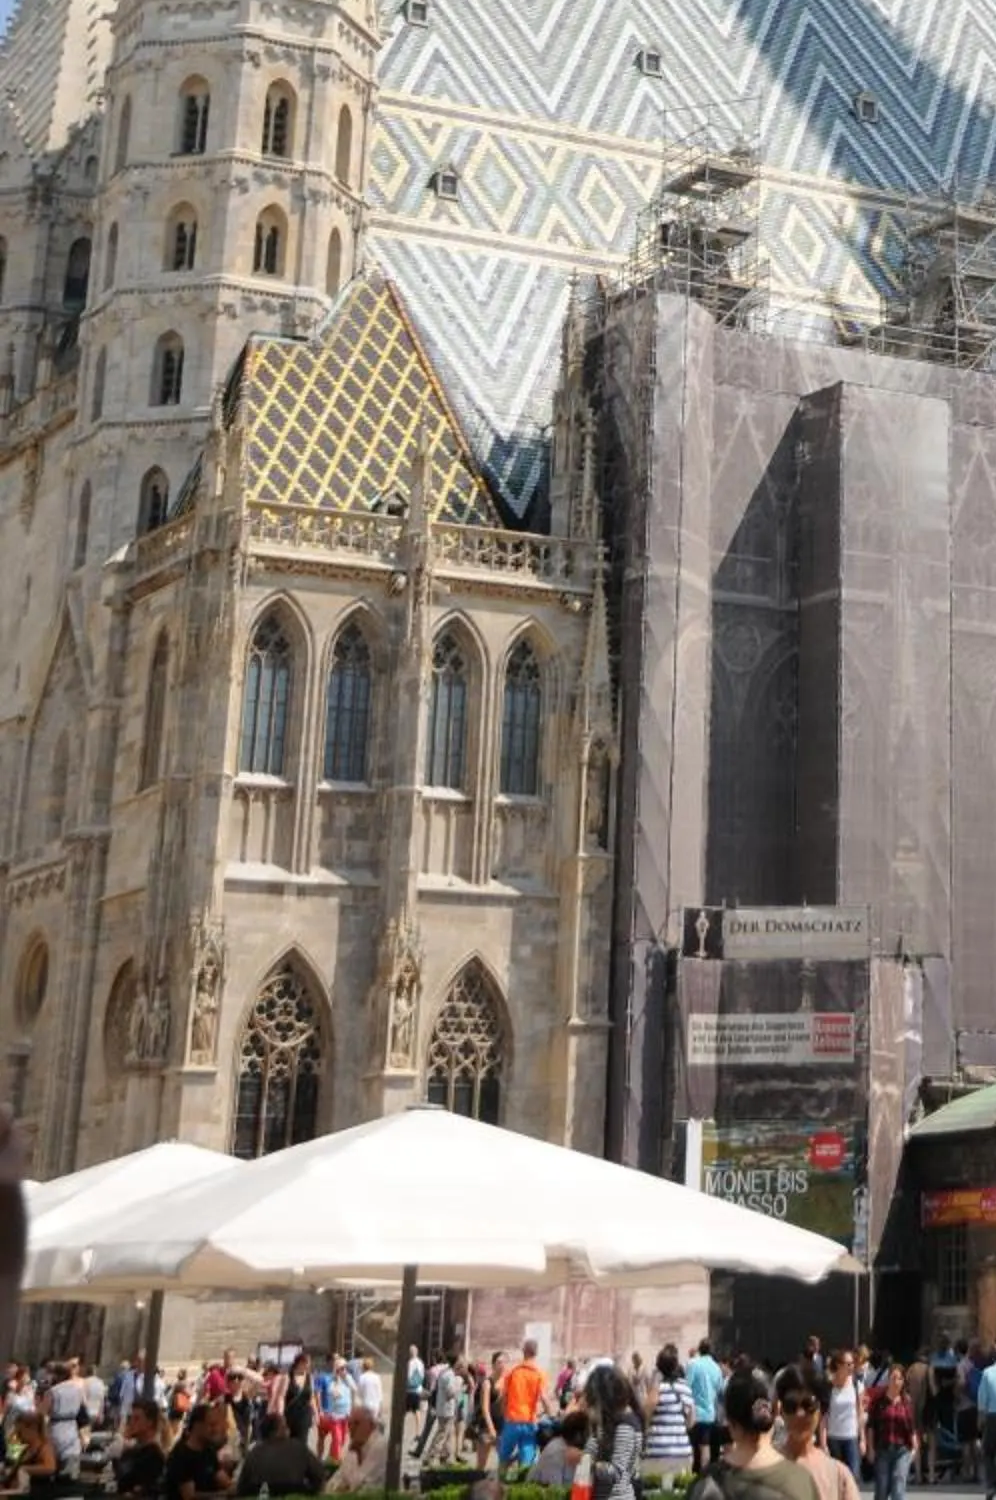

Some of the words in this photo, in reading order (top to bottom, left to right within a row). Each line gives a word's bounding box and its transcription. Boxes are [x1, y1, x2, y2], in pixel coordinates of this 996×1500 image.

[730, 920, 760, 934] DER
[765, 919, 862, 933] DOMSCHATZ
[705, 1169, 775, 1194] MONET
[777, 1169, 809, 1194] BIS
